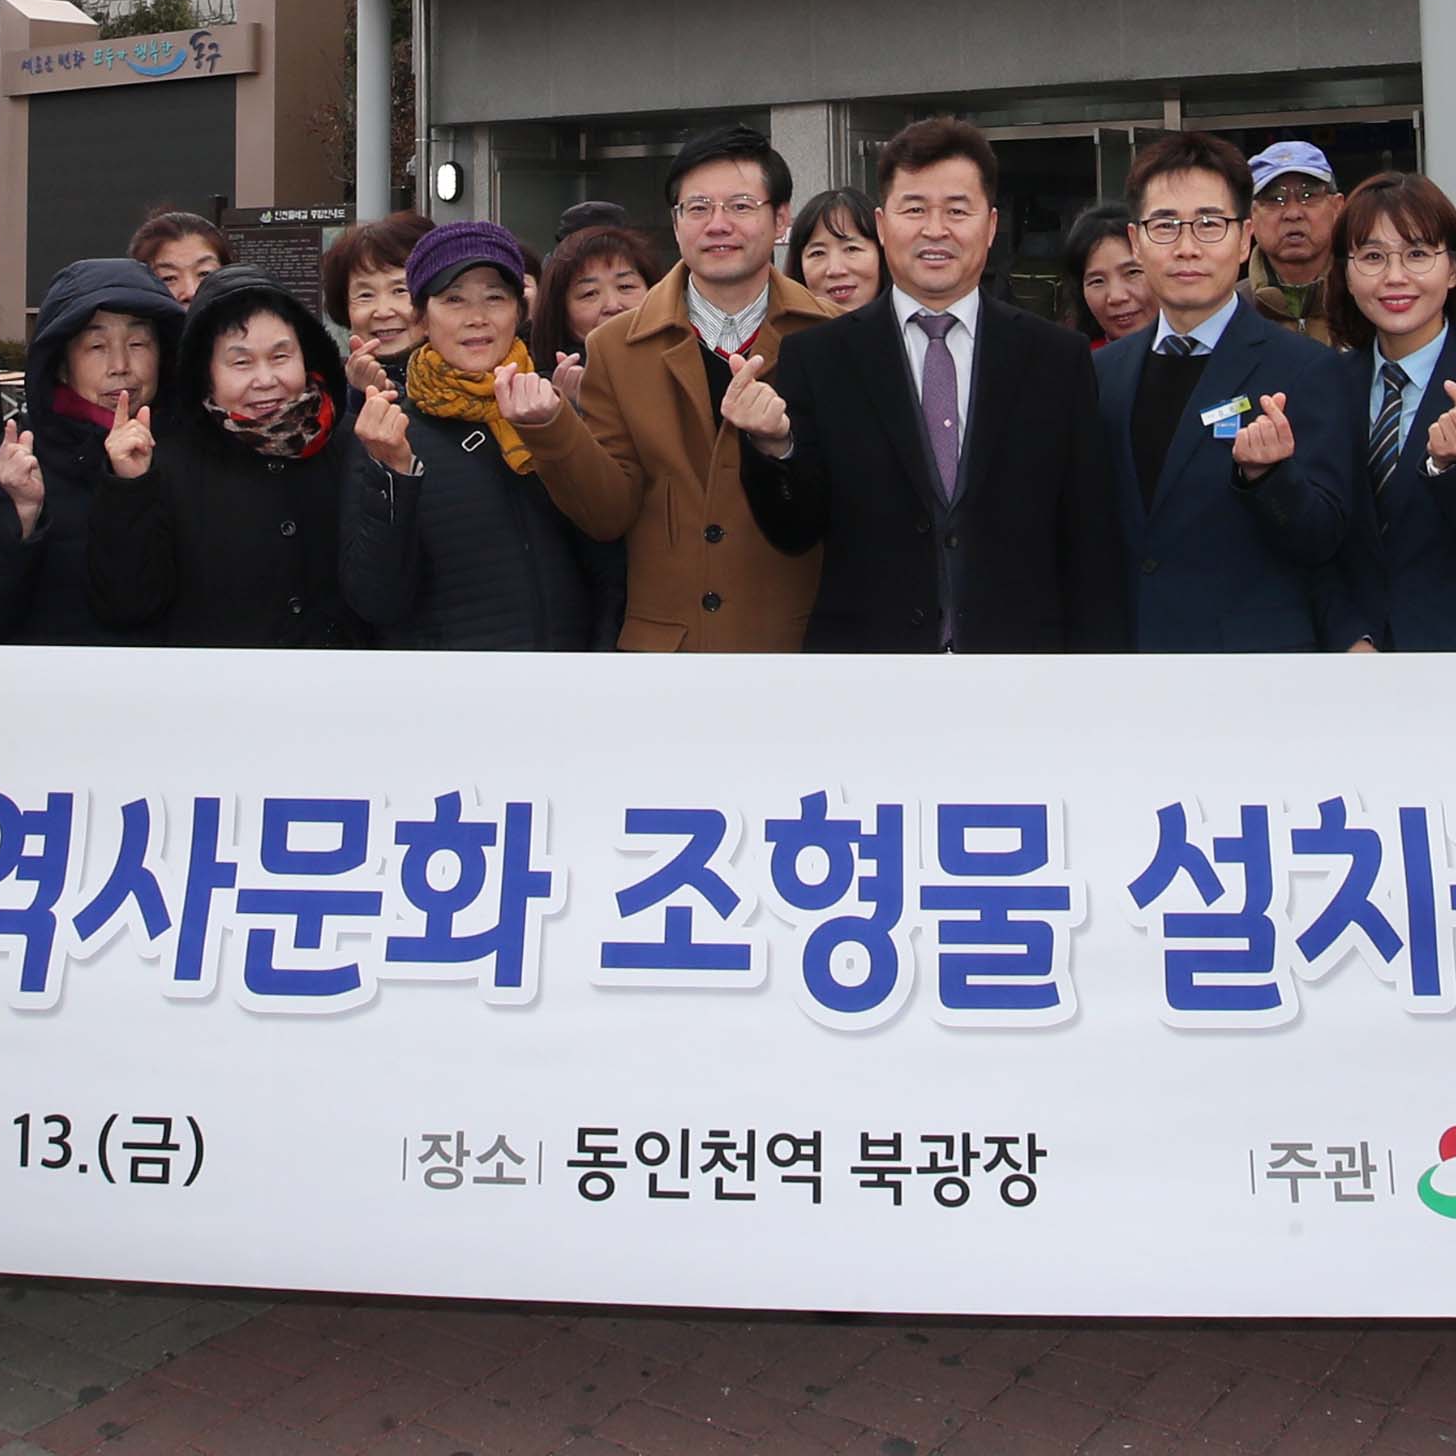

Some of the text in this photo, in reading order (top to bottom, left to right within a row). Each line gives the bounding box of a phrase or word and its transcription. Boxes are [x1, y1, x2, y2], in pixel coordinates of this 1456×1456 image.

[601, 790, 1071, 1014] 조형물
[12, 1112, 205, 1186] 13.(금)
[417, 1127, 1048, 1208] 장소 동인천역 북광장
[1265, 1141, 1378, 1203] 주관
